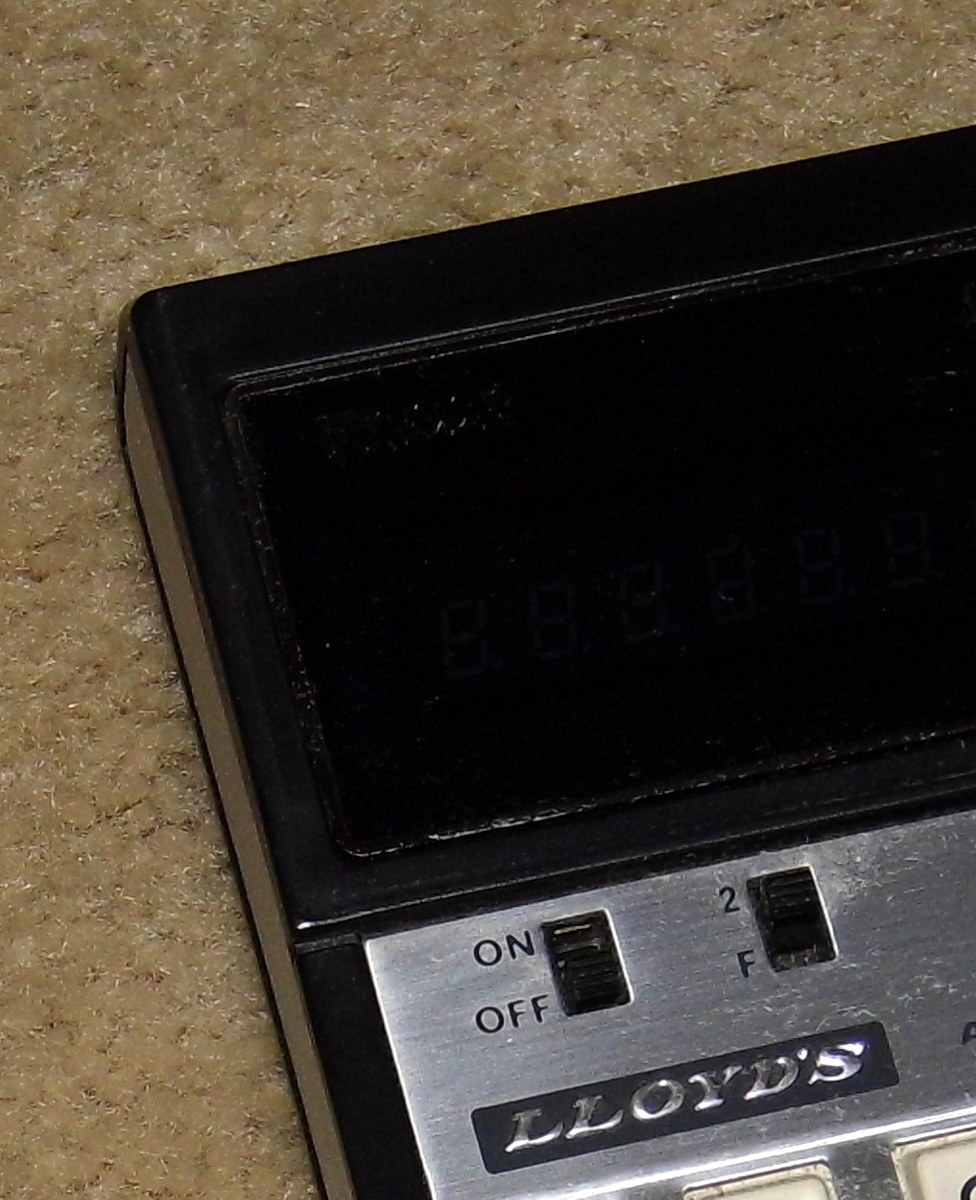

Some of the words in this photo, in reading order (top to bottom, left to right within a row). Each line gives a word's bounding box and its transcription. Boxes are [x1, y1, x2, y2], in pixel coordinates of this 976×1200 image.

[719, 887, 741, 914] 2
[474, 931, 535, 967] ON
[737, 950, 756, 979] F
[476, 995, 549, 1034] OFF
[504, 1040, 868, 1152] LLOYD'S
